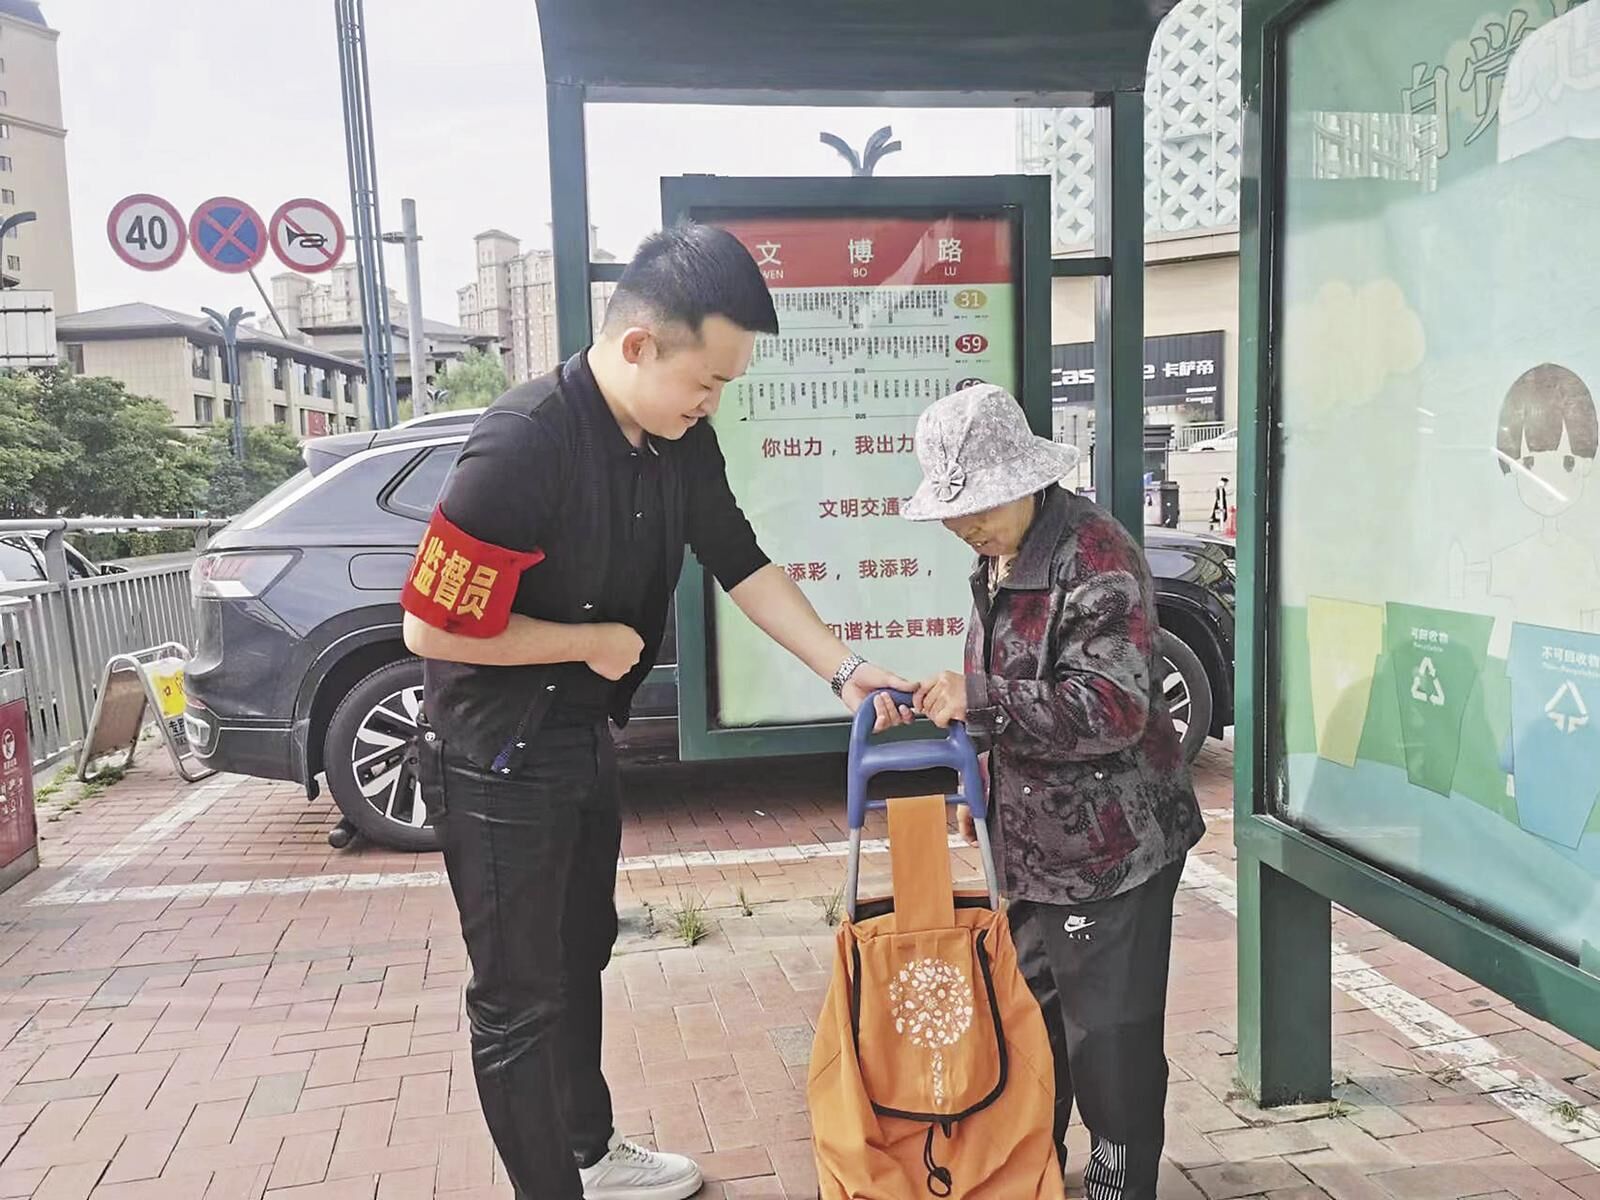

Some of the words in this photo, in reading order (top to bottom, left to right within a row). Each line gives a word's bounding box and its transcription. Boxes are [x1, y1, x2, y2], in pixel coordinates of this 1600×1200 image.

[126, 215, 168, 251] 40
[853, 268, 868, 278] BO
[944, 267, 957, 277] LU
[960, 291, 980, 308] 31
[961, 335, 982, 352] 59
[761, 435, 837, 459] 你出力，
[818, 495, 912, 519] 文明交通
[410, 526, 499, 621] 监督员
[858, 557, 932, 579] 我添彩，
